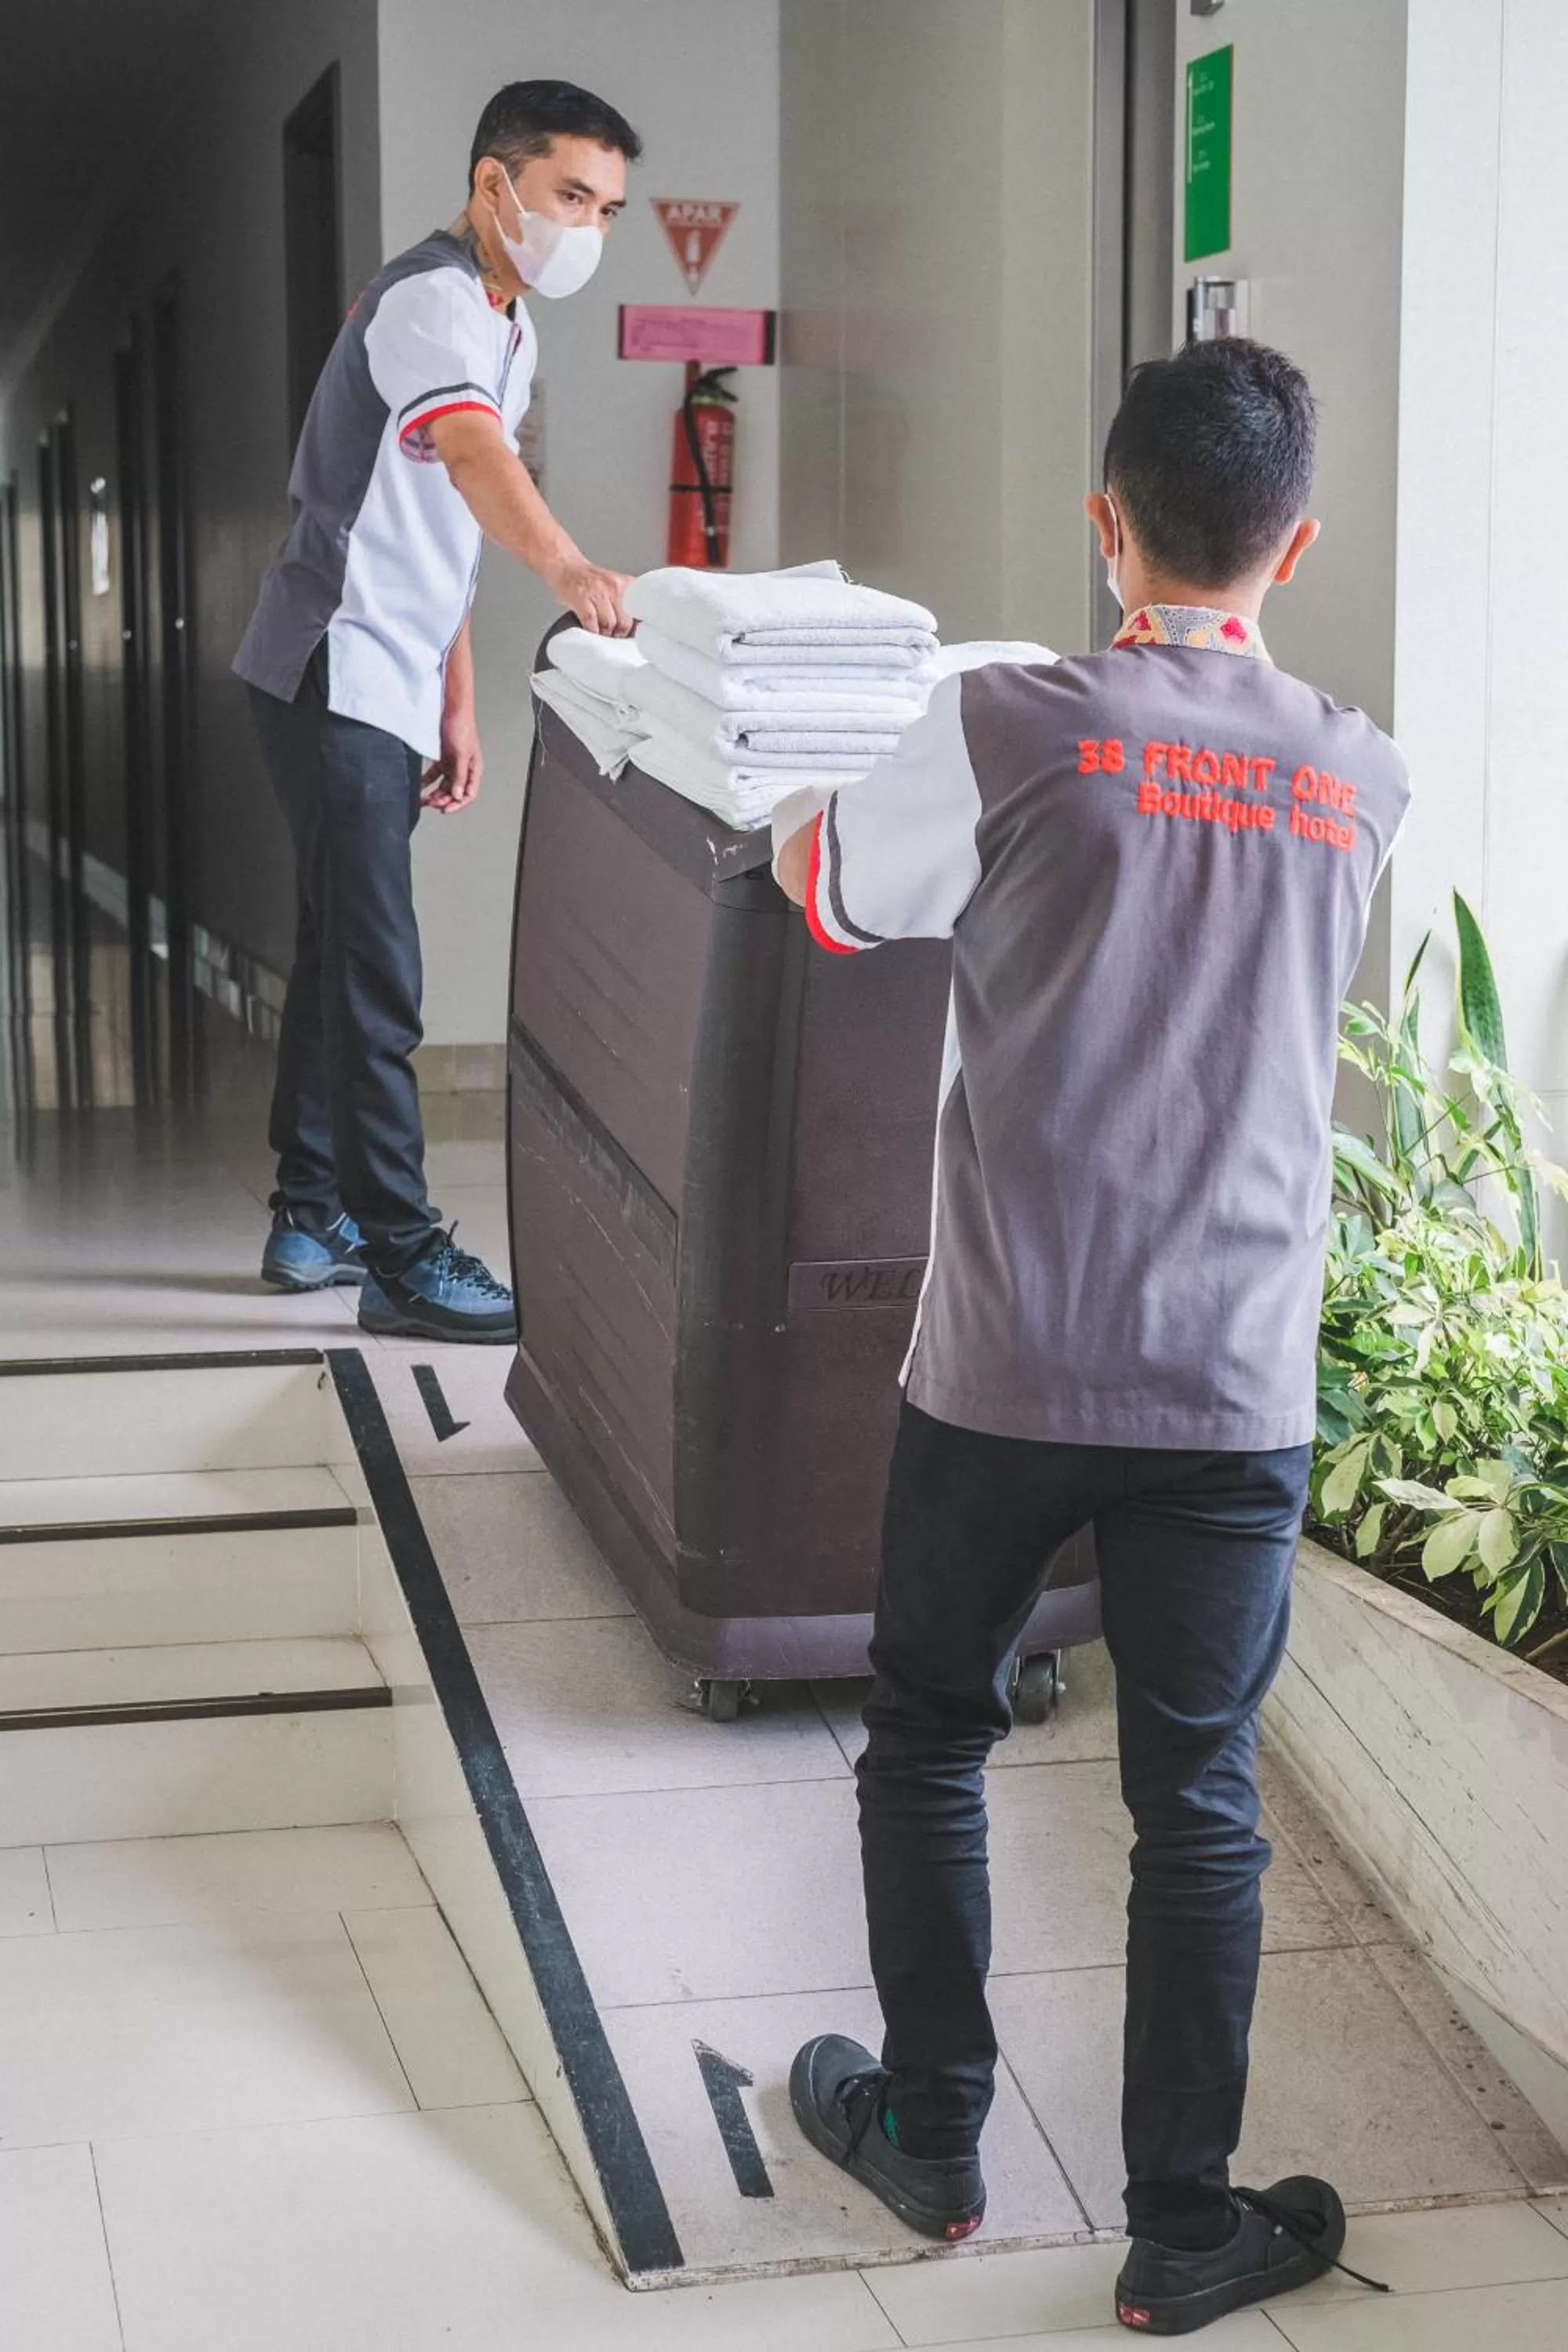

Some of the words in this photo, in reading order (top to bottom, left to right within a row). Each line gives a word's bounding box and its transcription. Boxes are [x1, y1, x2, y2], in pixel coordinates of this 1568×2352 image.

[1143, 739, 1276, 791] FRONT
[1291, 764, 1356, 818] ONE
[1138, 782, 1276, 833] Boutique
[1289, 804, 1356, 853] hotel
